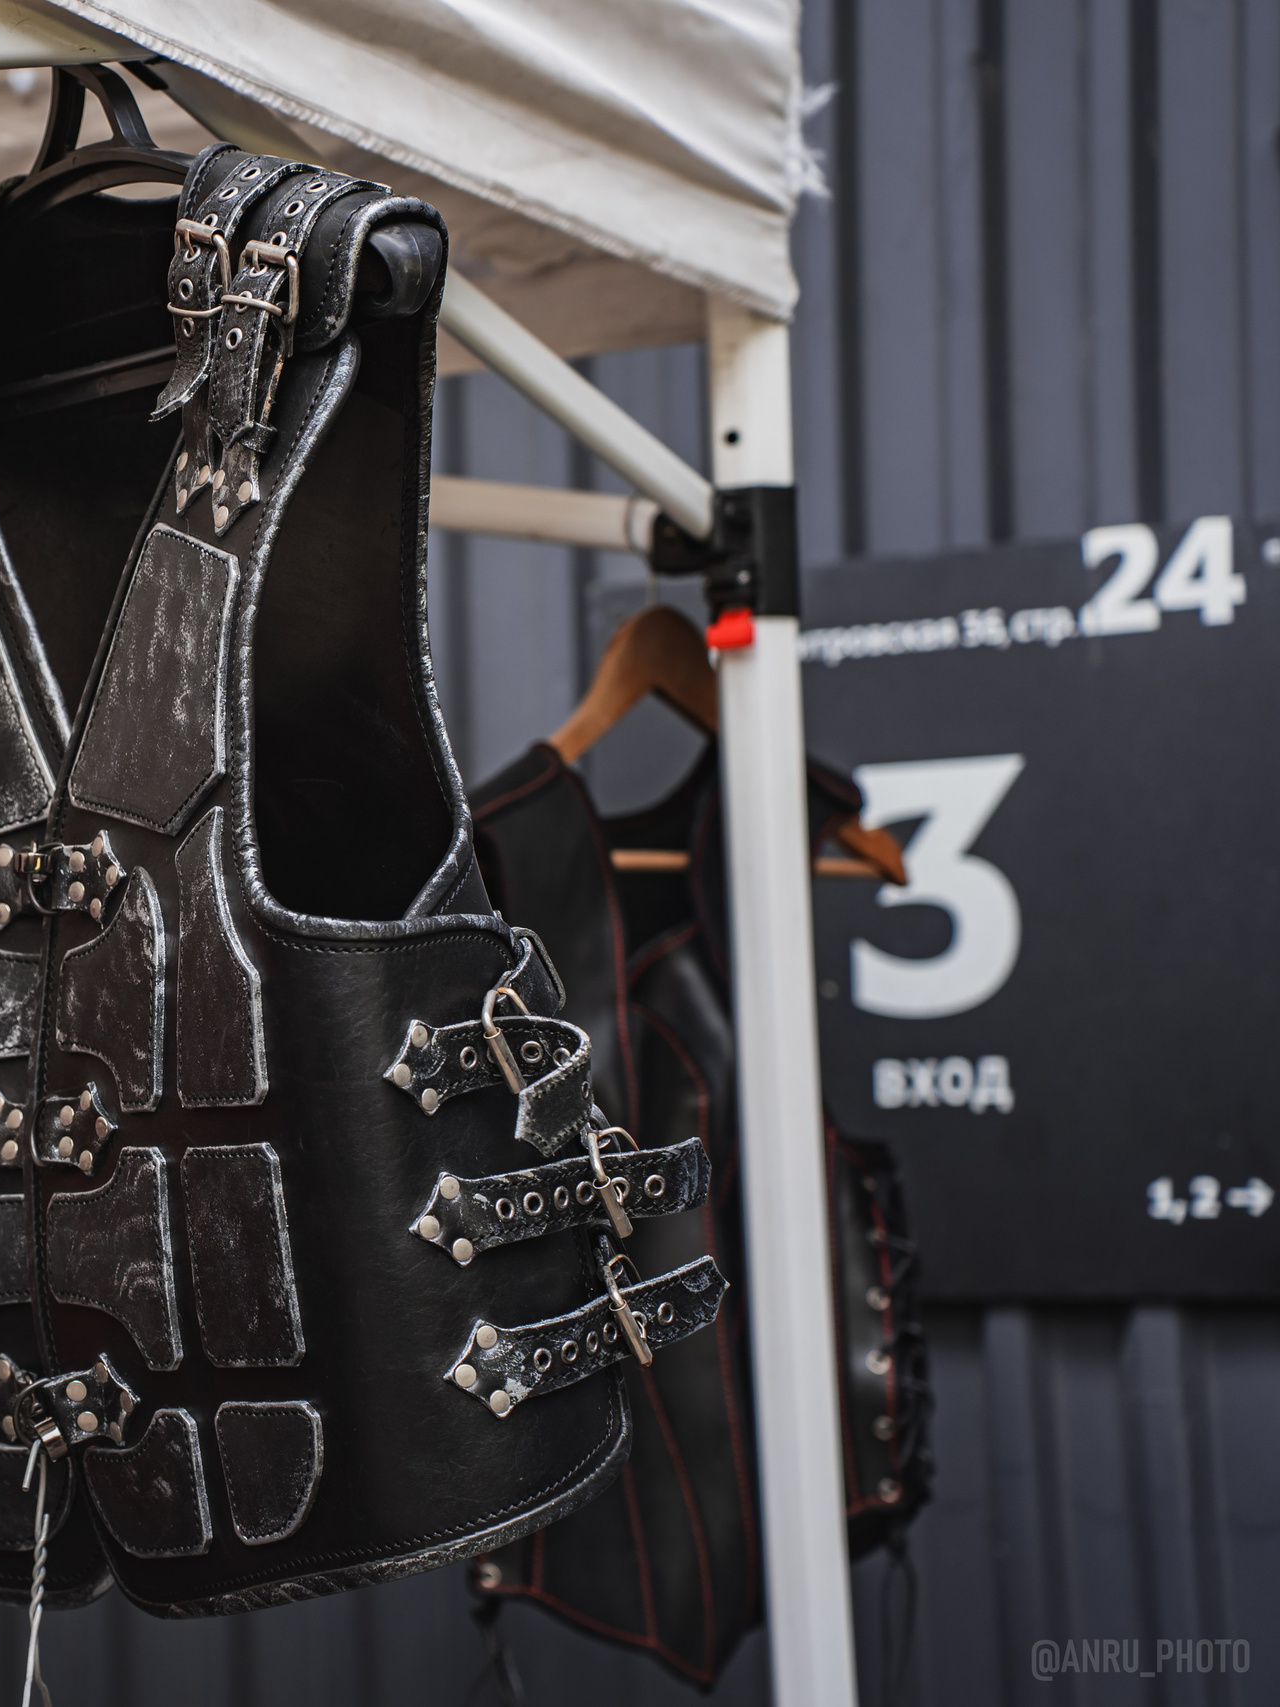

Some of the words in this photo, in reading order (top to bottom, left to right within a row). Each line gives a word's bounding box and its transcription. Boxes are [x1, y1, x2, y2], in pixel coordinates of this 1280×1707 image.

[1080, 514, 1248, 637] 24
[849, 752, 1026, 1021] 3
[873, 1054, 1015, 1114] ВХОД
